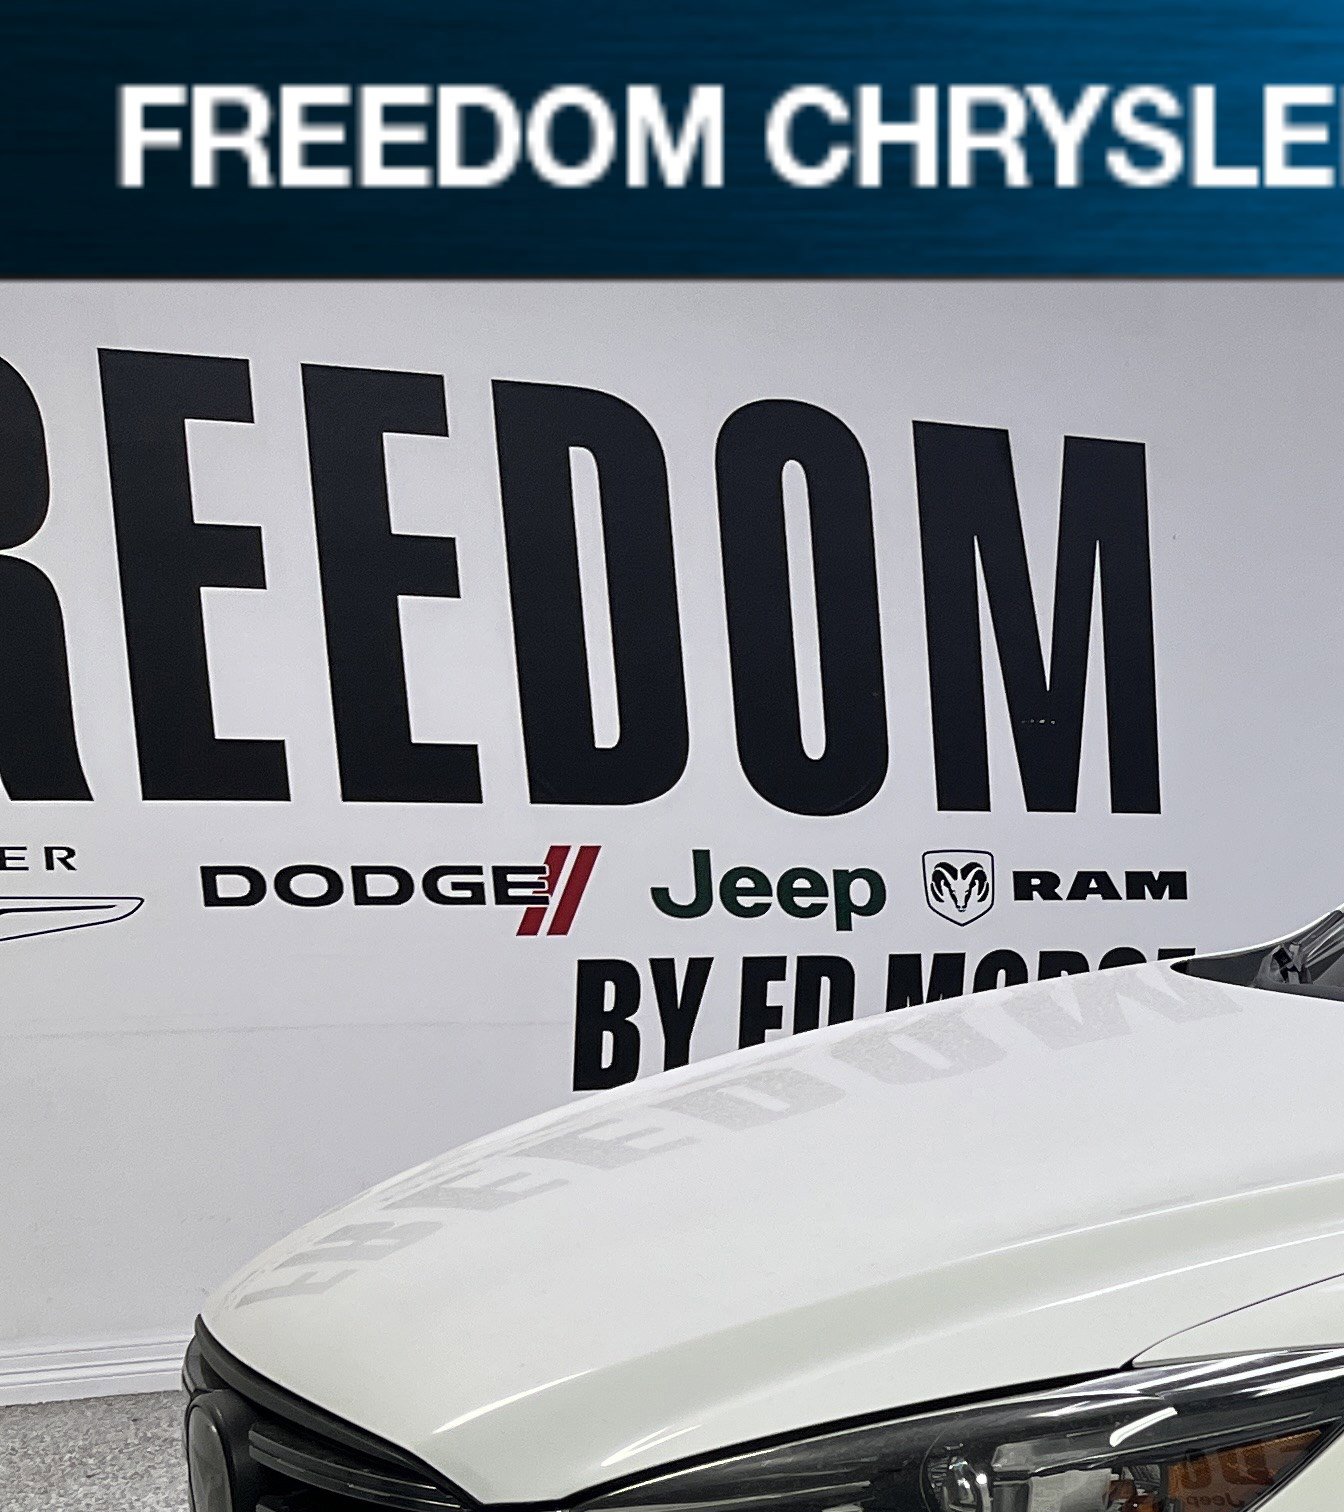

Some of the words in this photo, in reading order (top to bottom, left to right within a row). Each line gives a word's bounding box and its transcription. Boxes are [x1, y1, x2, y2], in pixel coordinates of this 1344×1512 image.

[200, 864, 550, 907] DODGE
[650, 849, 887, 931] Jeep
[1012, 870, 1189, 901] RAM
[572, 956, 714, 1092] BY
[738, 953, 857, 1053] ED
